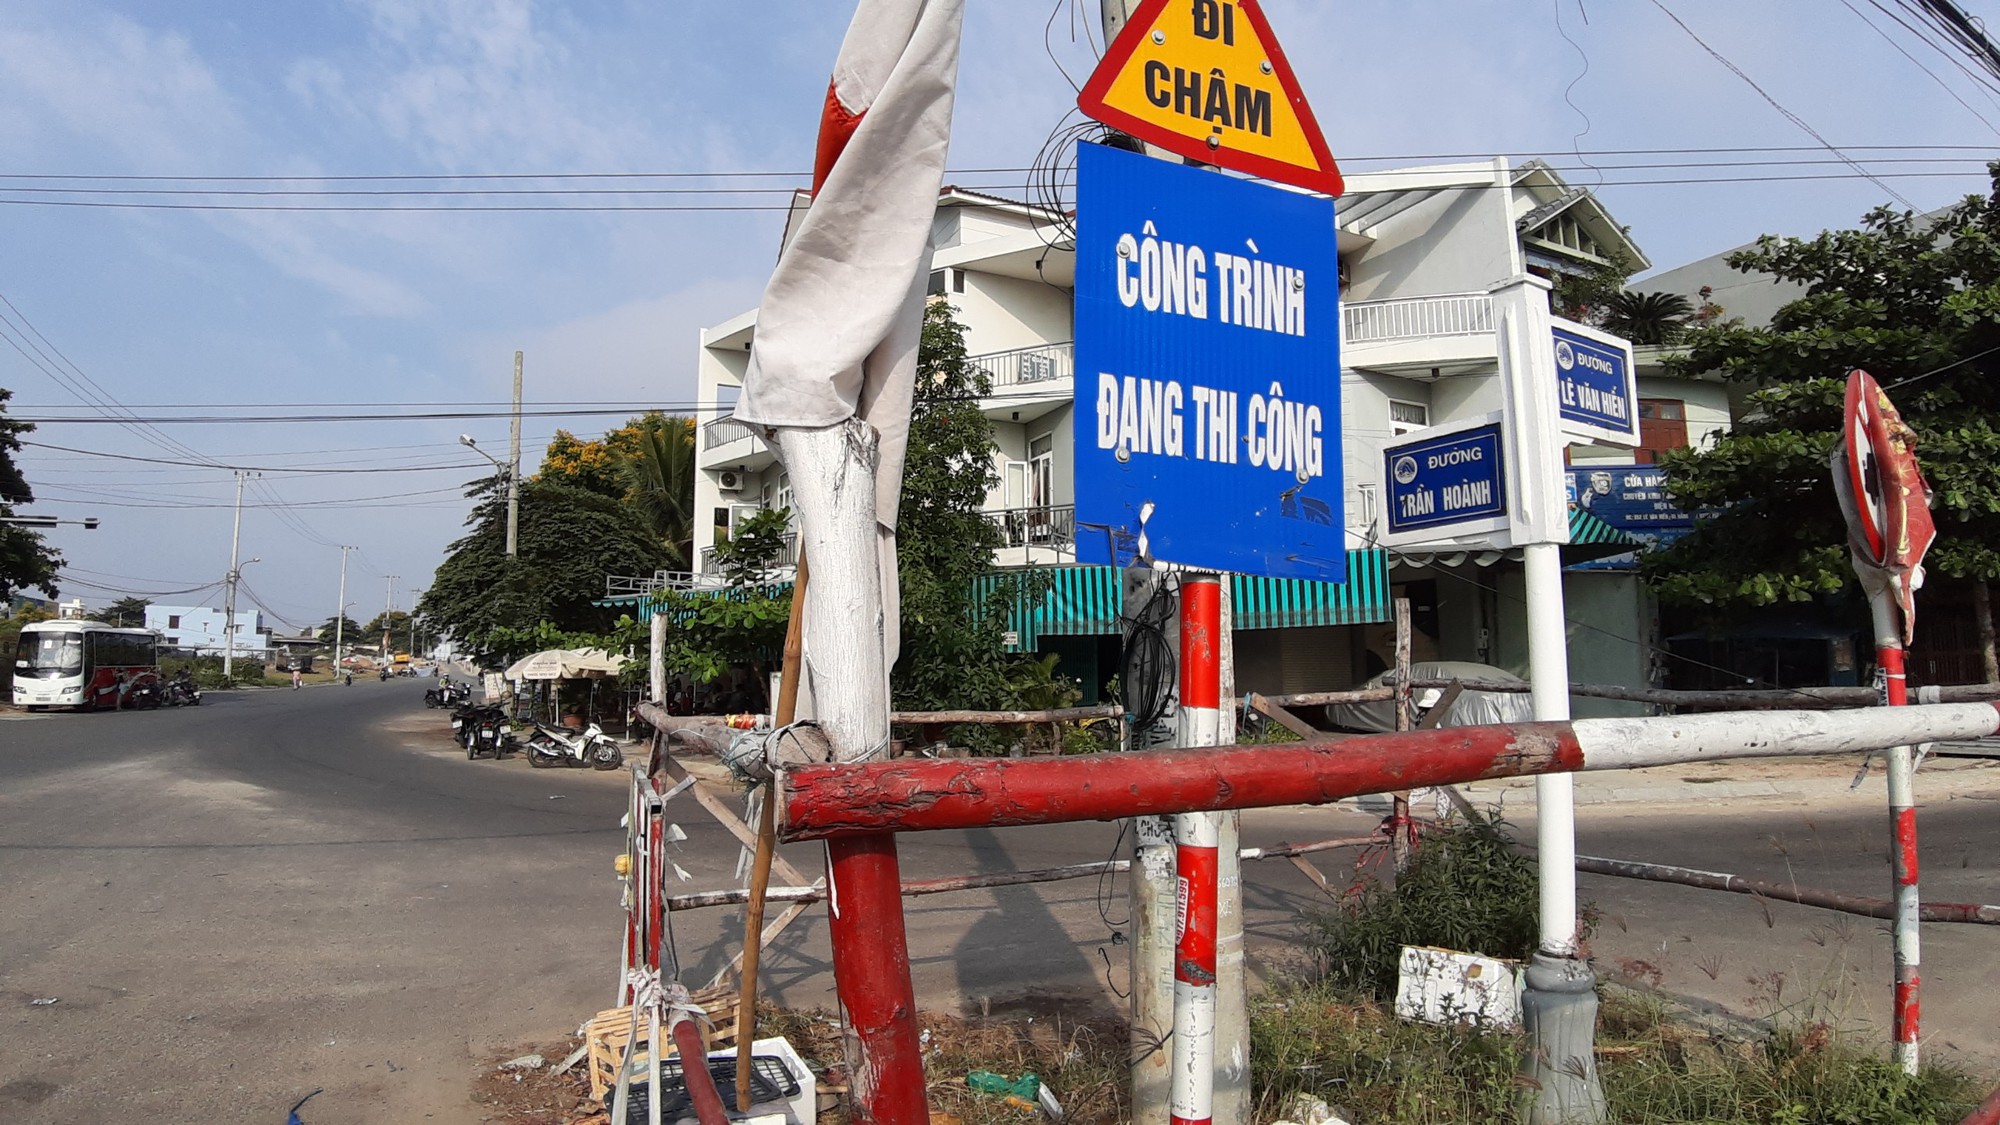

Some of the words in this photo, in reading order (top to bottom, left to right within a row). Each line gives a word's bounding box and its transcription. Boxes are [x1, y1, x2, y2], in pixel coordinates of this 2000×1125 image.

[1191, 0, 1234, 47] ĐI
[1144, 60, 1272, 138] CHẬM
[1117, 220, 1207, 319] CÔNG
[1214, 238, 1305, 337] TRÌNH
[1577, 352, 1613, 375] ĐƯỜNG
[1561, 377, 1576, 406] LÊ
[1576, 381, 1601, 412] VĂN
[1601, 385, 1626, 420] HIẾN
[1096, 372, 1183, 457] ĐANG
[1192, 385, 1237, 464] THI
[1248, 381, 1323, 478] CÔNG
[1428, 447, 1483, 470] ĐƯỜNG
[1400, 483, 1435, 518] TRẦN
[1443, 478, 1492, 511] HOÀNH
[1624, 473, 1643, 488] CỬA
